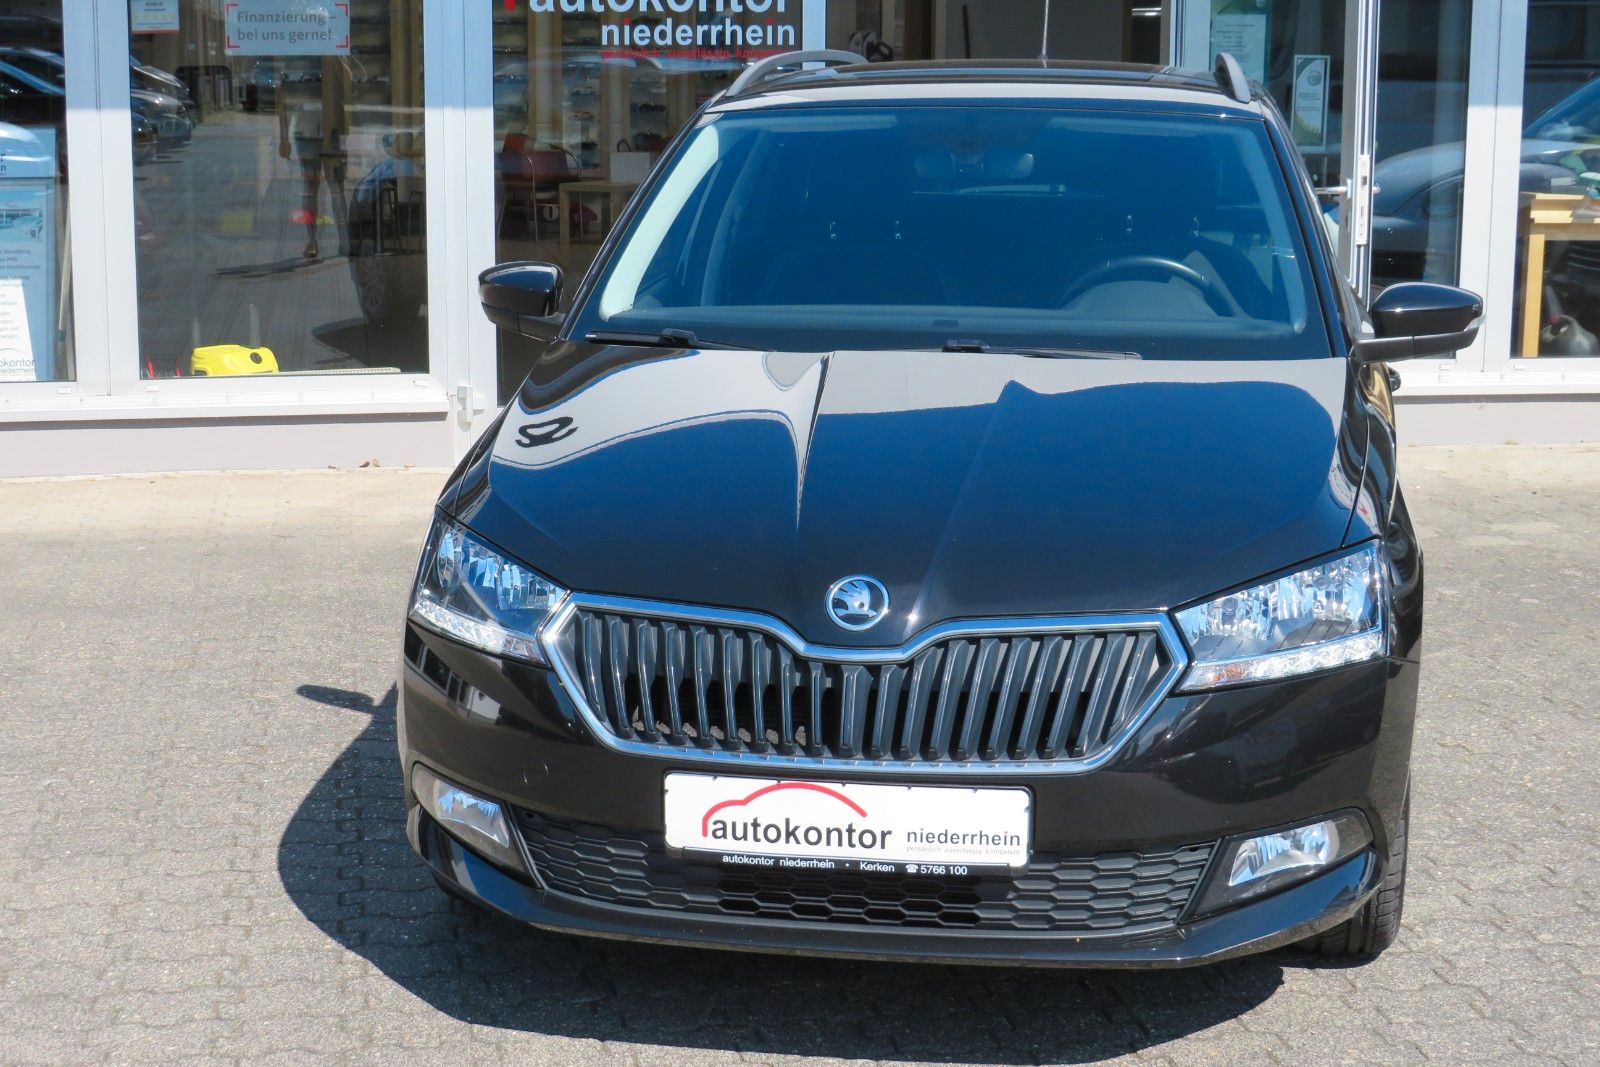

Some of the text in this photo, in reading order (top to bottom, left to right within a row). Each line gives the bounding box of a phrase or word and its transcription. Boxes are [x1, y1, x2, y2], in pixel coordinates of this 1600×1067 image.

[237, 11, 325, 25] Finanzierung
[238, 28, 332, 43] bei uns gerne!
[602, 18, 796, 46] niederrhein
[711, 818, 1021, 849] autokontor niederrhein
[722, 854, 968, 875] autokontor niederrhein Kerken 5766 100
